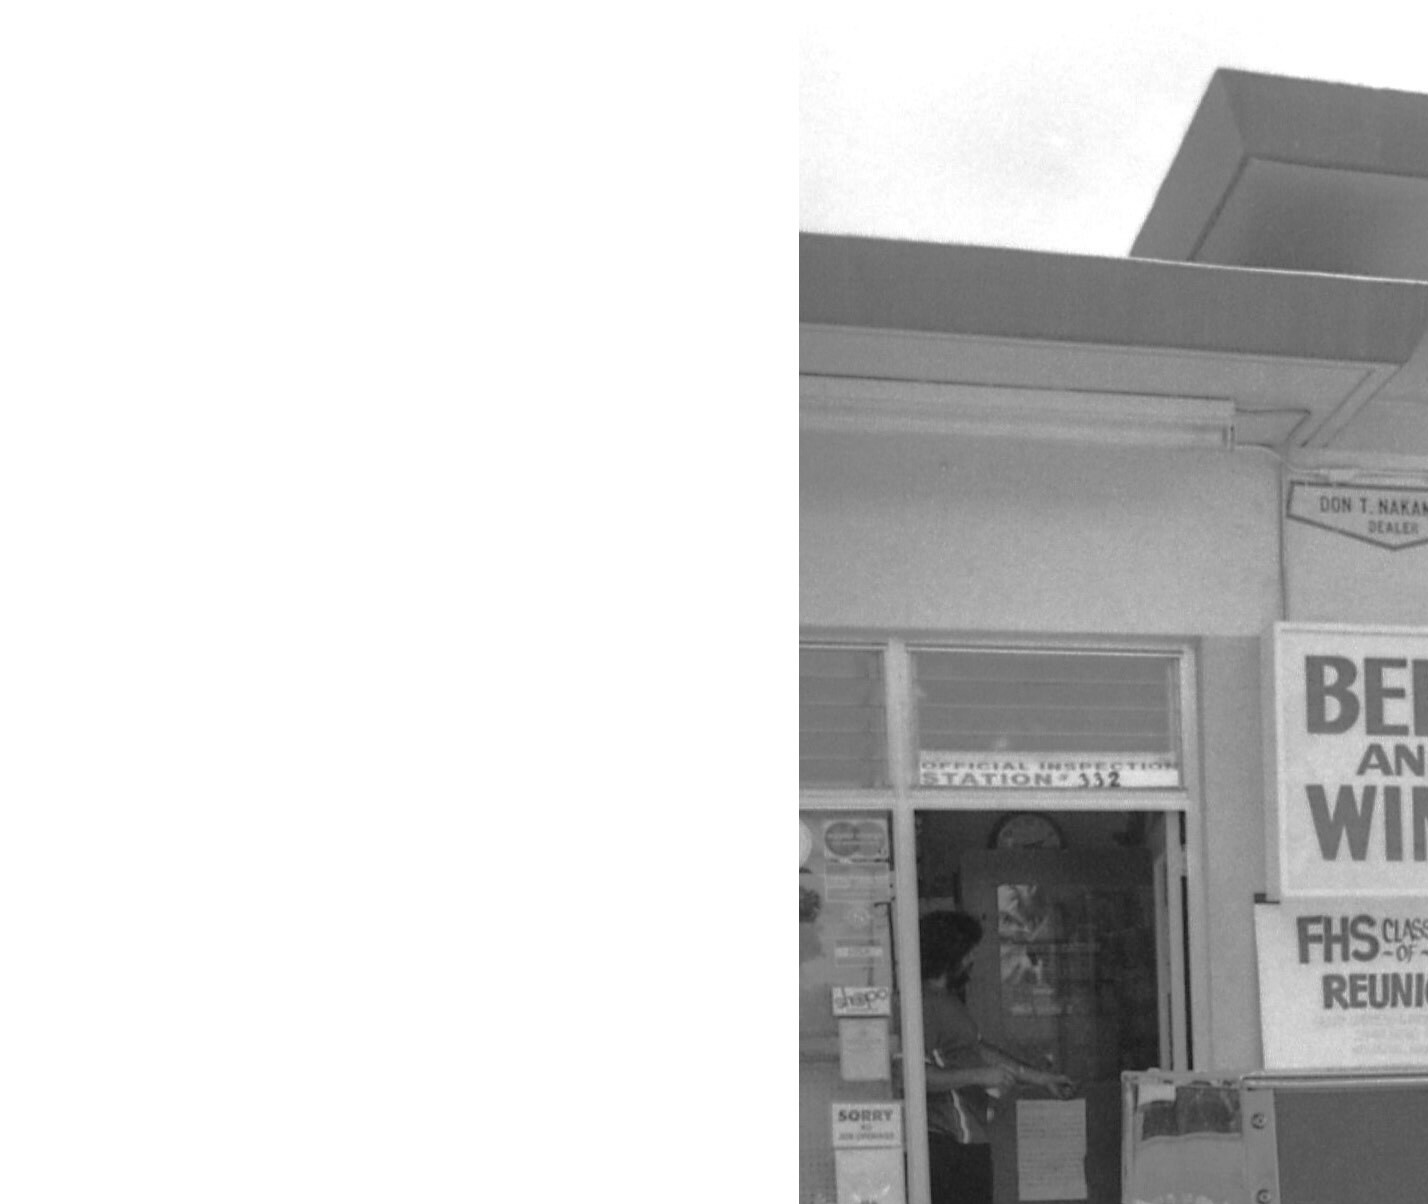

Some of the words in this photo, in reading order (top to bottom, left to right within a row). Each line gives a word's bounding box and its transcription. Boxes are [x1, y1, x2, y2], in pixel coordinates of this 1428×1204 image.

[1319, 496, 1352, 514] DON
[1368, 520, 1420, 535] DEALER
[920, 761, 1028, 771] OFFICIAL
[1039, 761, 1181, 771] INSPECTION
[922, 772, 1053, 787] STATION
[1078, 771, 1122, 788] 332
[1296, 914, 1380, 964] FHS
[838, 1109, 894, 1122] SORRY
